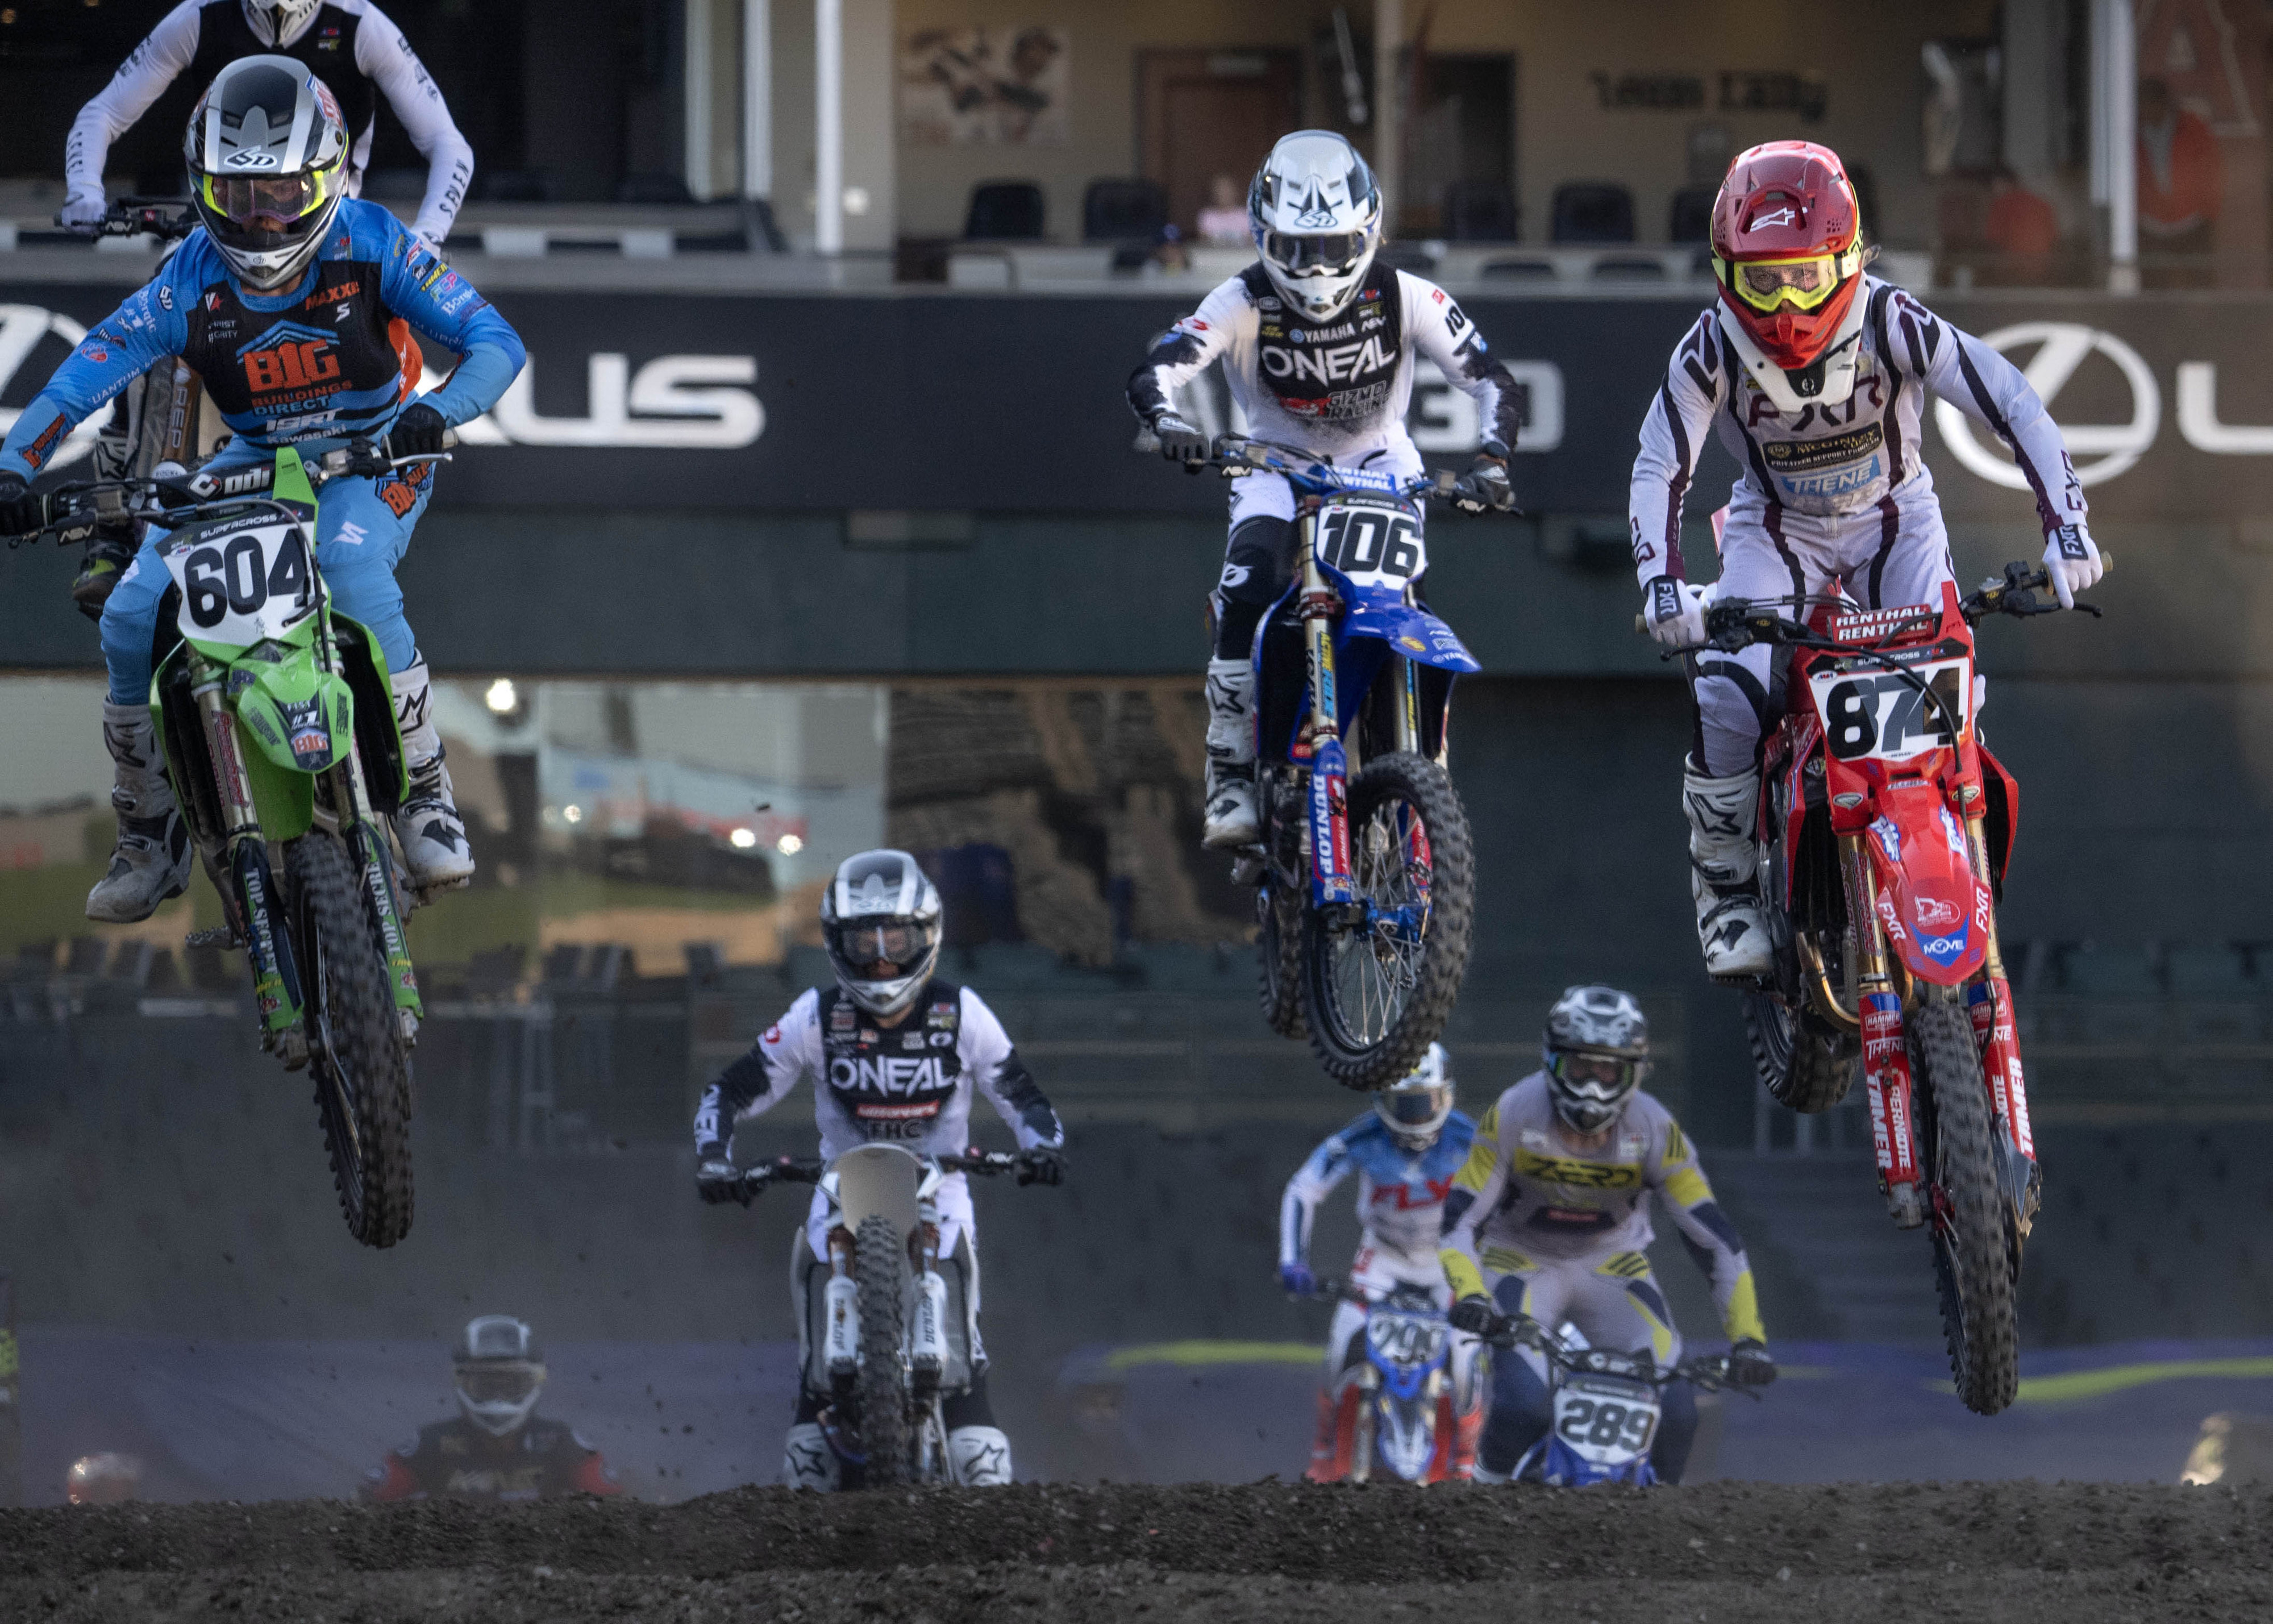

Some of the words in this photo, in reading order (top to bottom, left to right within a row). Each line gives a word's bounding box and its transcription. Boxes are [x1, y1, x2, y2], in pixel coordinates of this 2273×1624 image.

[1304, 322, 1356, 343] YAMAHA
[252, 379, 353, 408] BUILDINGS
[253, 396, 331, 416] DIRECT
[455, 351, 767, 450] US
[267, 424, 347, 445] Kawasaki
[1813, 449, 1847, 461] SUPPORT
[1322, 510, 1421, 576] 106
[184, 527, 310, 629] 604
[1657, 581, 1678, 615] FXR
[1835, 605, 1927, 627] RENTHAL
[1826, 667, 1964, 760] 874
[1312, 773, 1334, 875] DUNLOP
[245, 867, 264, 907] TOP
[1877, 901, 1906, 940] FXR
[1975, 886, 1989, 934] FXR
[382, 918, 401, 956] TOP
[1924, 938, 1964, 955] MOVE
[2007, 1055, 2034, 1154] TAMER
[1560, 1397, 1655, 1453] 289
